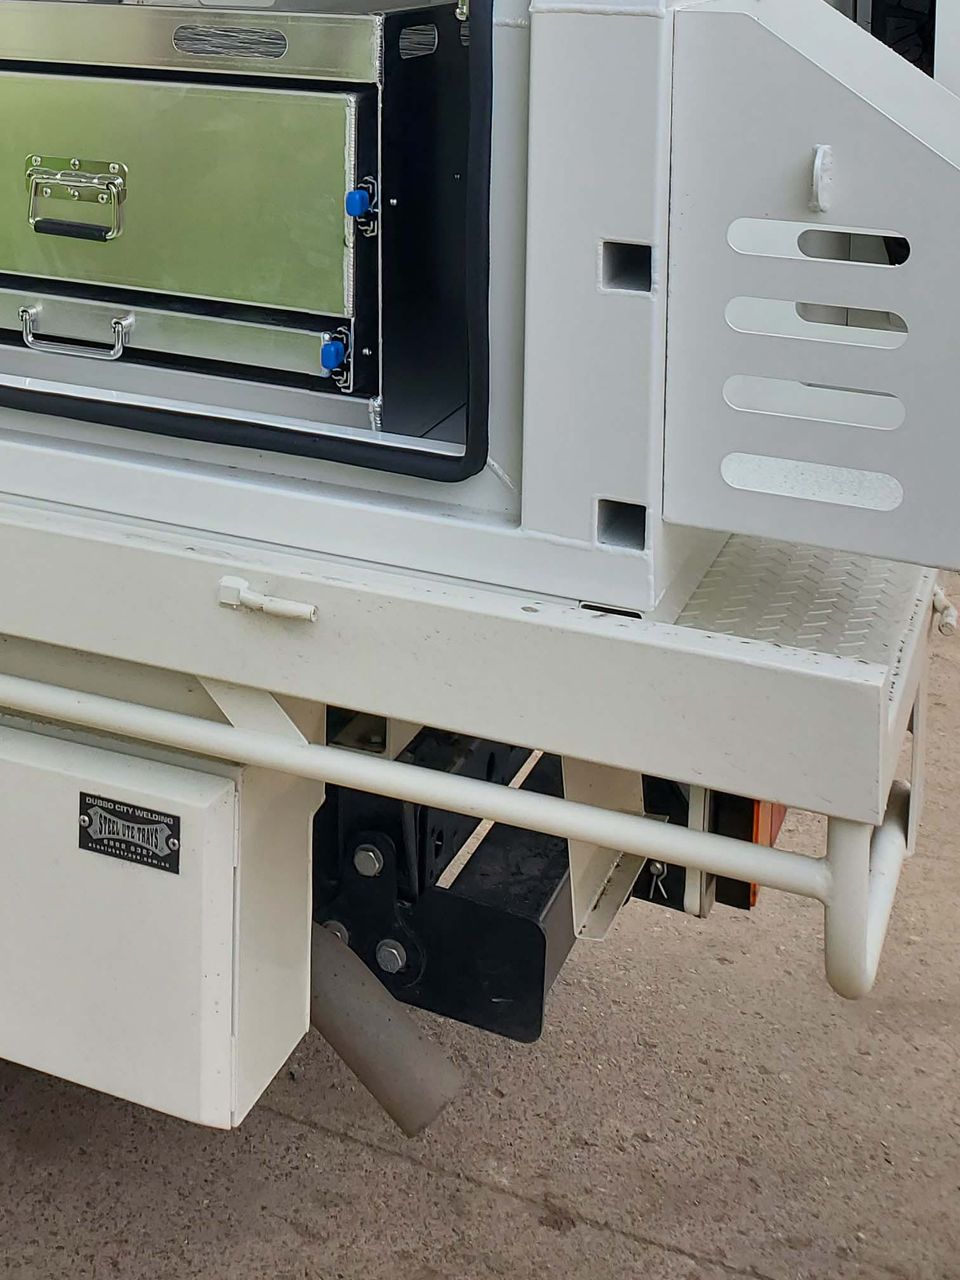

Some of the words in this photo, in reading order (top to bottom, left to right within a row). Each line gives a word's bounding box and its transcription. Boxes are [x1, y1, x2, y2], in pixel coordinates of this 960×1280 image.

[86, 796, 114, 809] DUBBO
[115, 804, 134, 815] CITY
[134, 808, 174, 825] WELDING
[98, 813, 120, 836] STEEL
[121, 823, 136, 840] UTE
[137, 826, 160, 850] TRAYS
